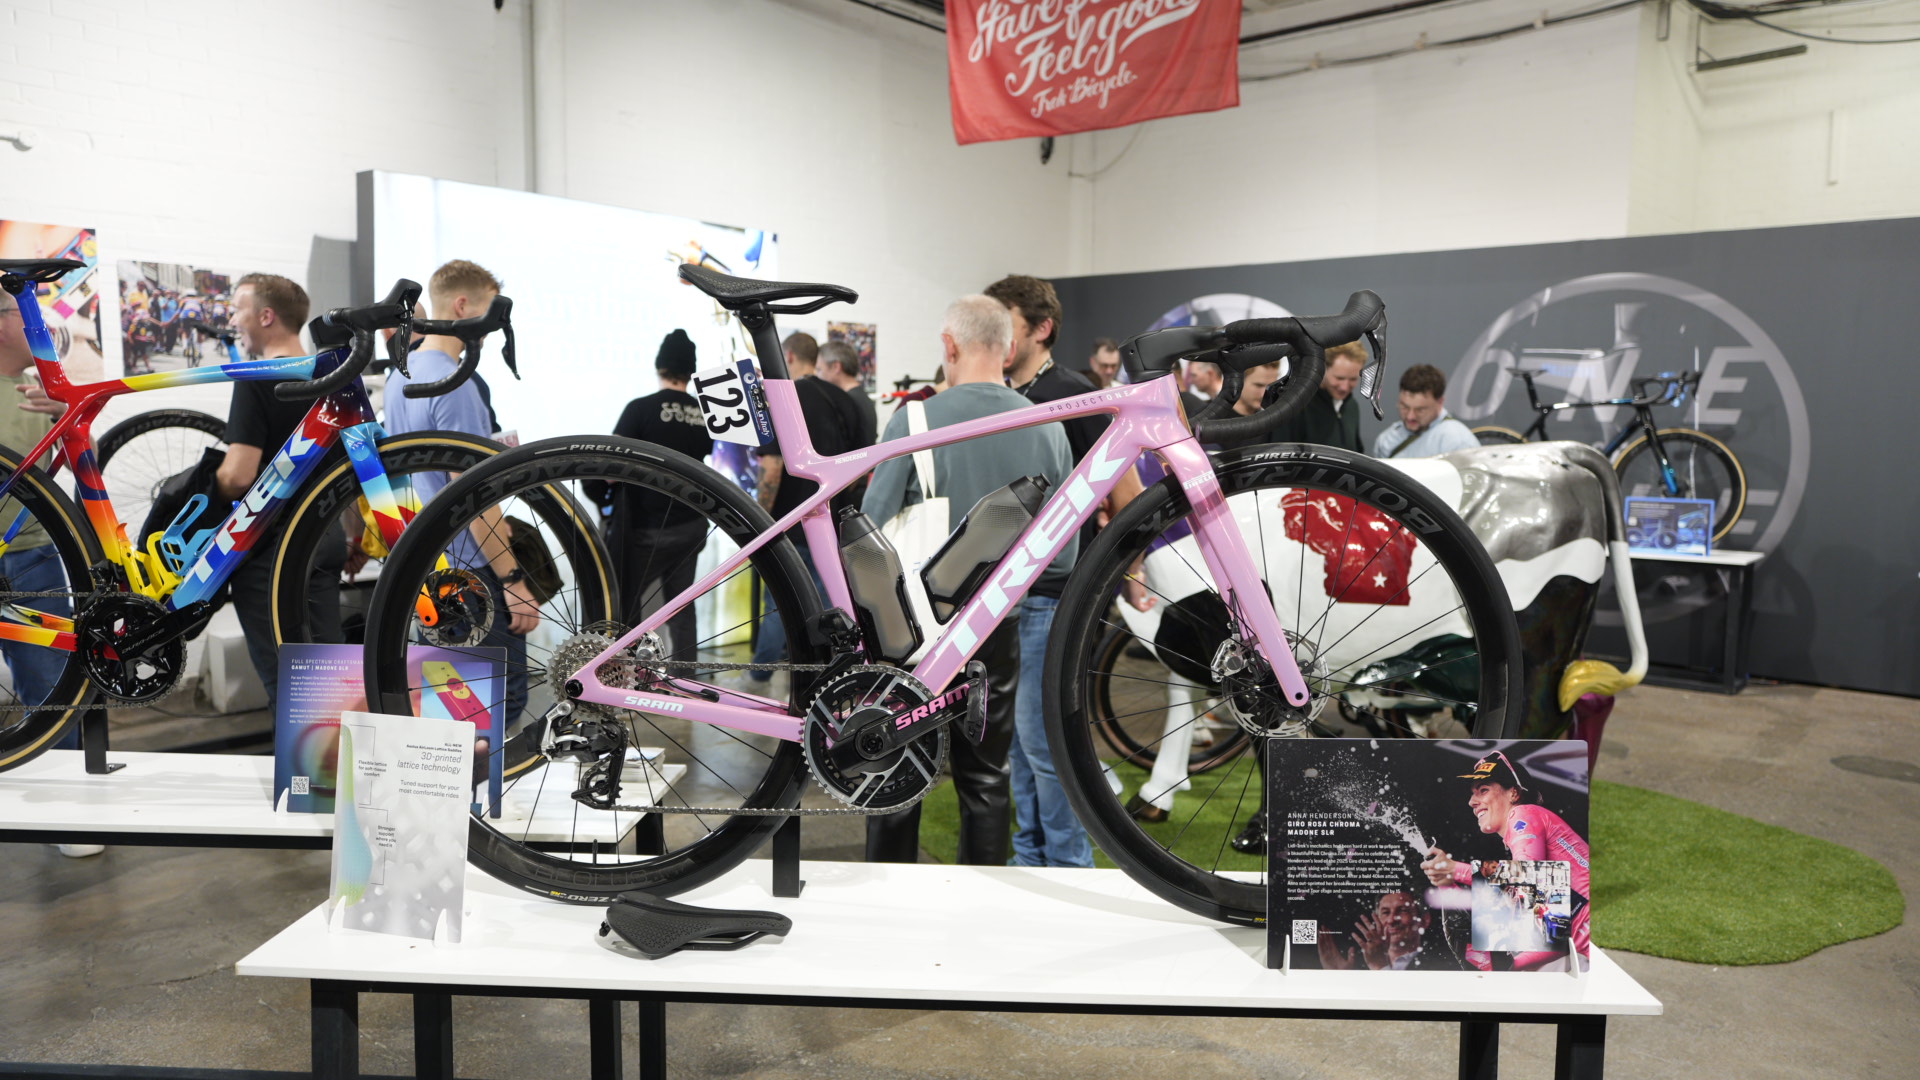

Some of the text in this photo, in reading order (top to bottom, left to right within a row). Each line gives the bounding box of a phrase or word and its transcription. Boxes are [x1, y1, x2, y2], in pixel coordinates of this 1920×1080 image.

[1005, 16, 1098, 96] Feel
[694, 368, 750, 434] 123
[569, 444, 631, 454] PIRELLI
[1254, 452, 1316, 461] PIRELLI
[834, 450, 868, 465] HENDERSON
[183, 422, 317, 584] TREK
[934, 437, 1127, 657] TREK
[624, 696, 684, 712] SRAM
[895, 683, 971, 731] SRAM
[420, 751, 462, 763] 3D-printed
[396, 760, 461, 775] lattice technology
[400, 779, 416, 787] Tuned
[417, 781, 438, 790] support
[413, 789, 445, 797] comfortable
